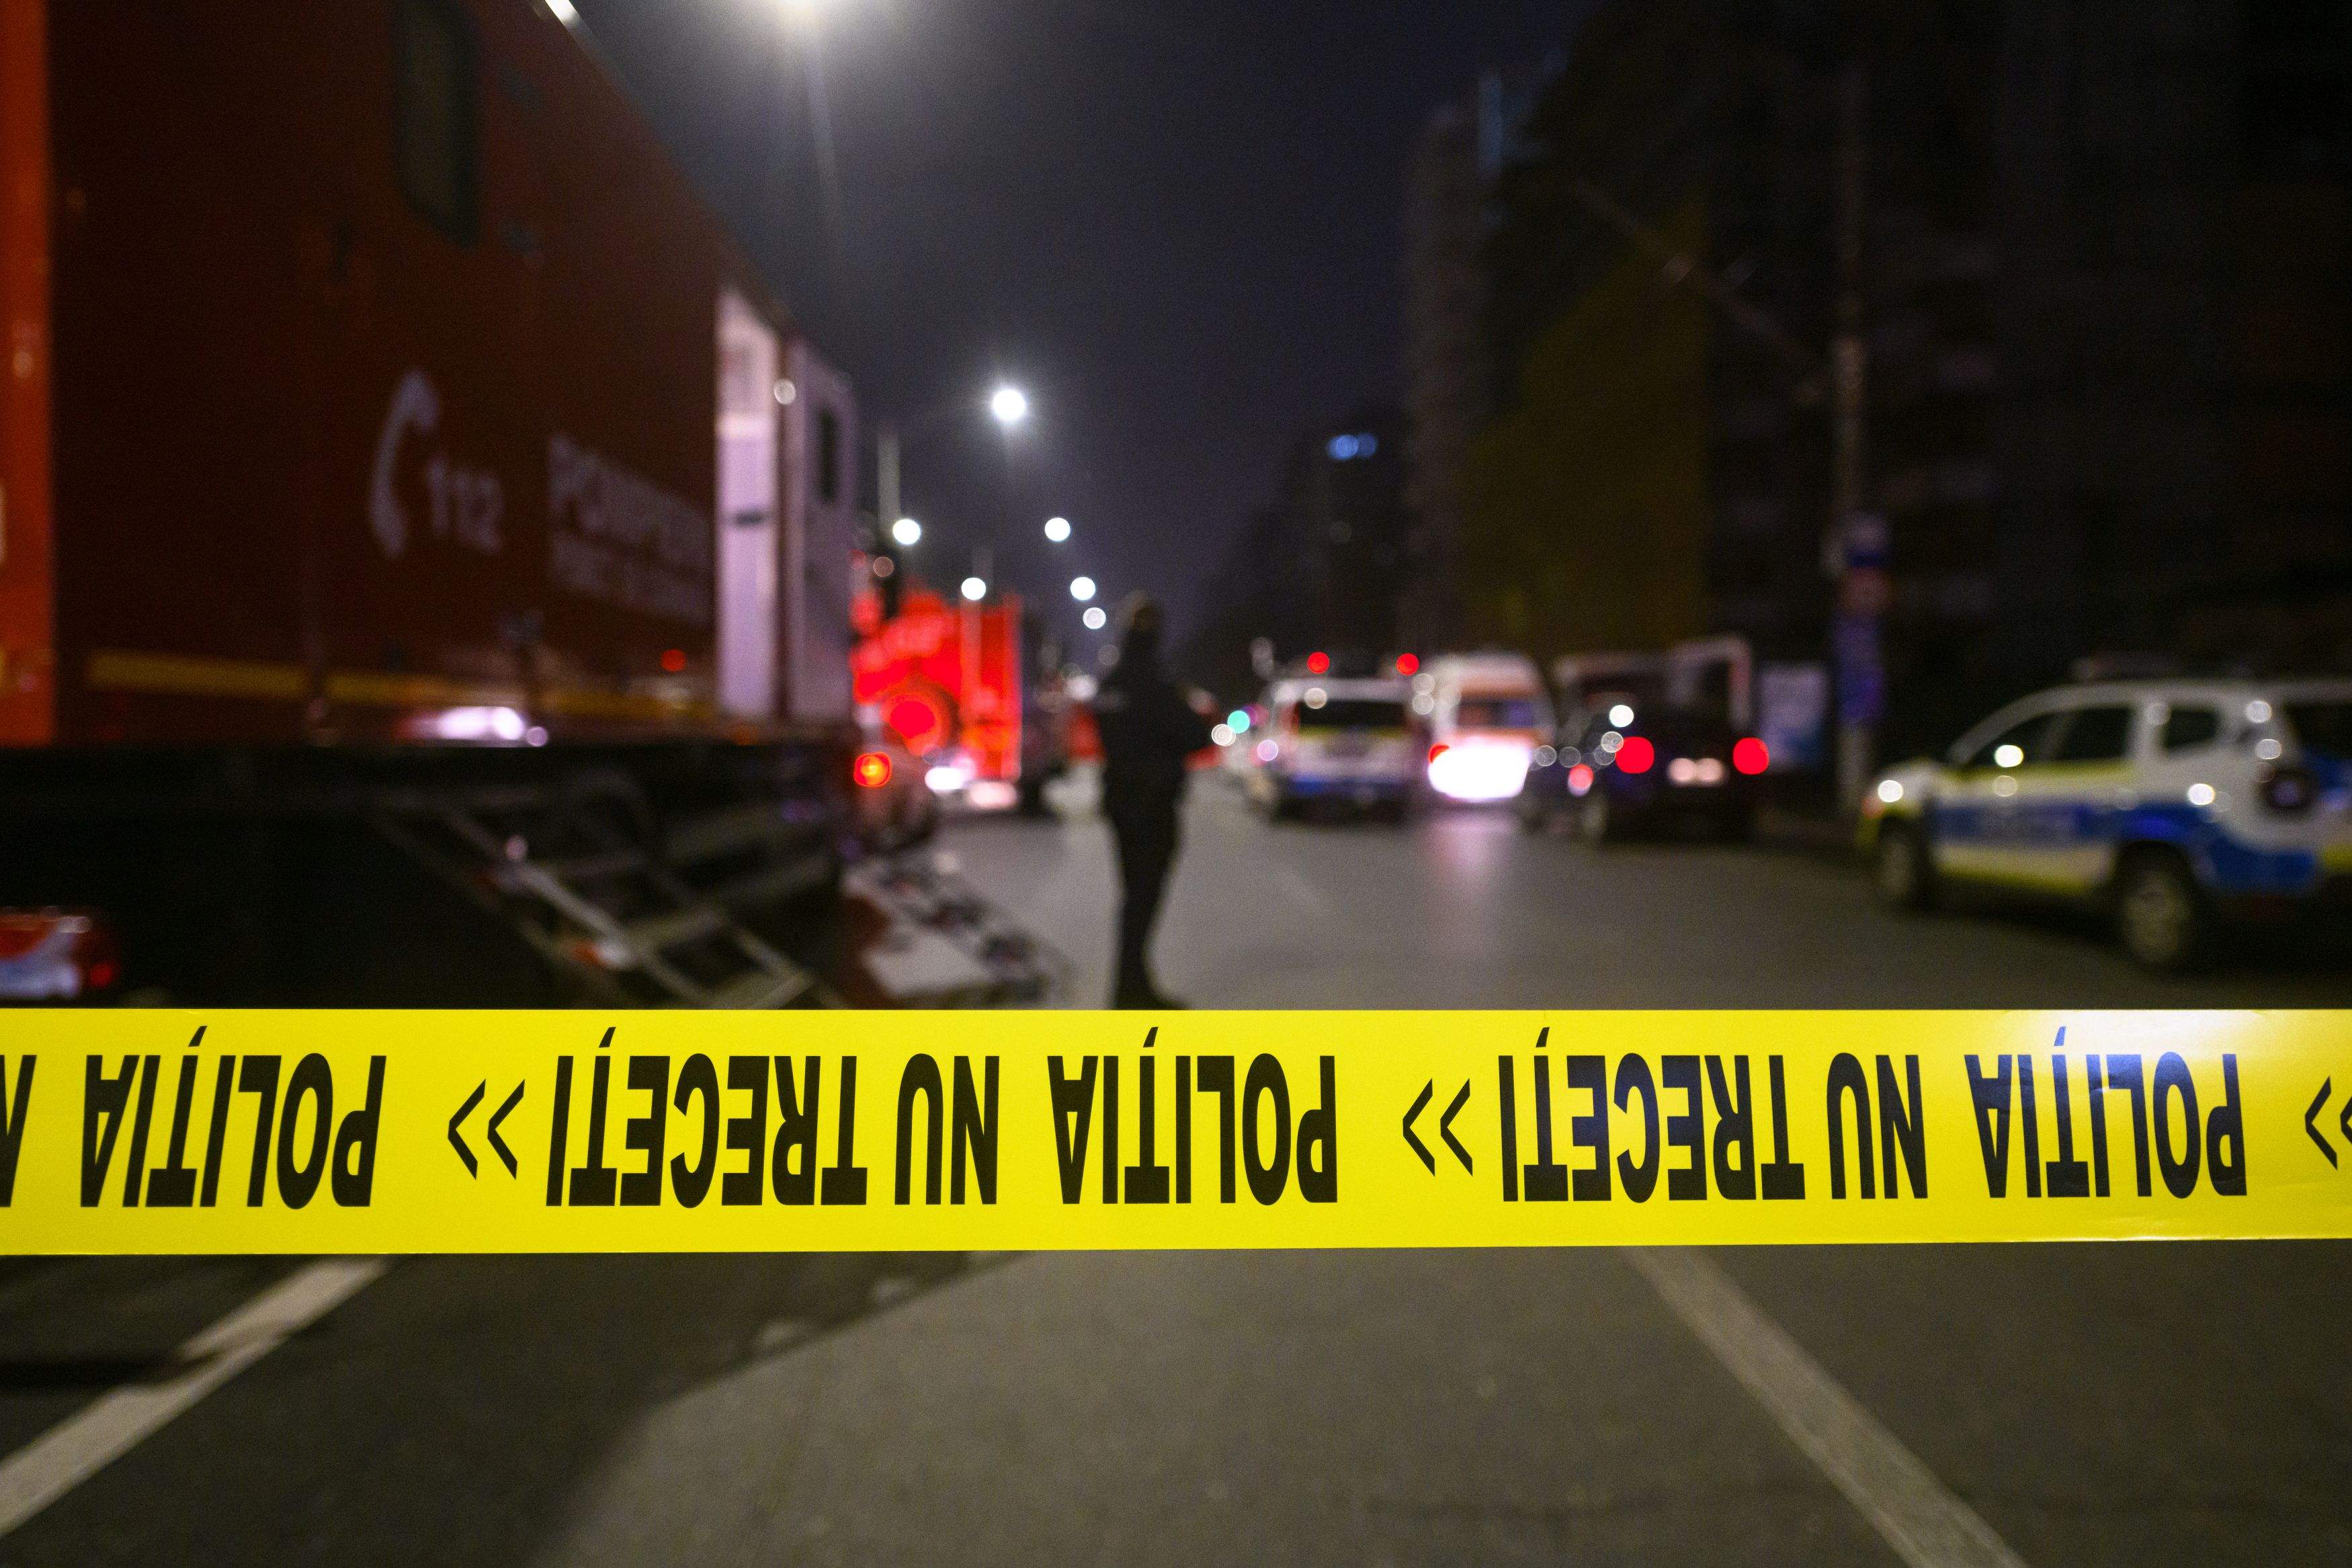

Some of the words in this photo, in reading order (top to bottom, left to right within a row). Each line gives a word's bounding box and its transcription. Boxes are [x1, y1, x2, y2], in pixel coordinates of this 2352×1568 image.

[425, 451, 504, 555] 112
[80, 1025, 387, 1210] POLIȚIA
[546, 1025, 868, 1209] TRECEȚI
[894, 1053, 1000, 1205] NU
[1048, 1027, 1338, 1206] POLIȚIA
[1498, 1027, 1806, 1204] TRECEȚI
[1826, 1052, 1929, 1200] NU
[1964, 1027, 2248, 1199] POLIȚIA
